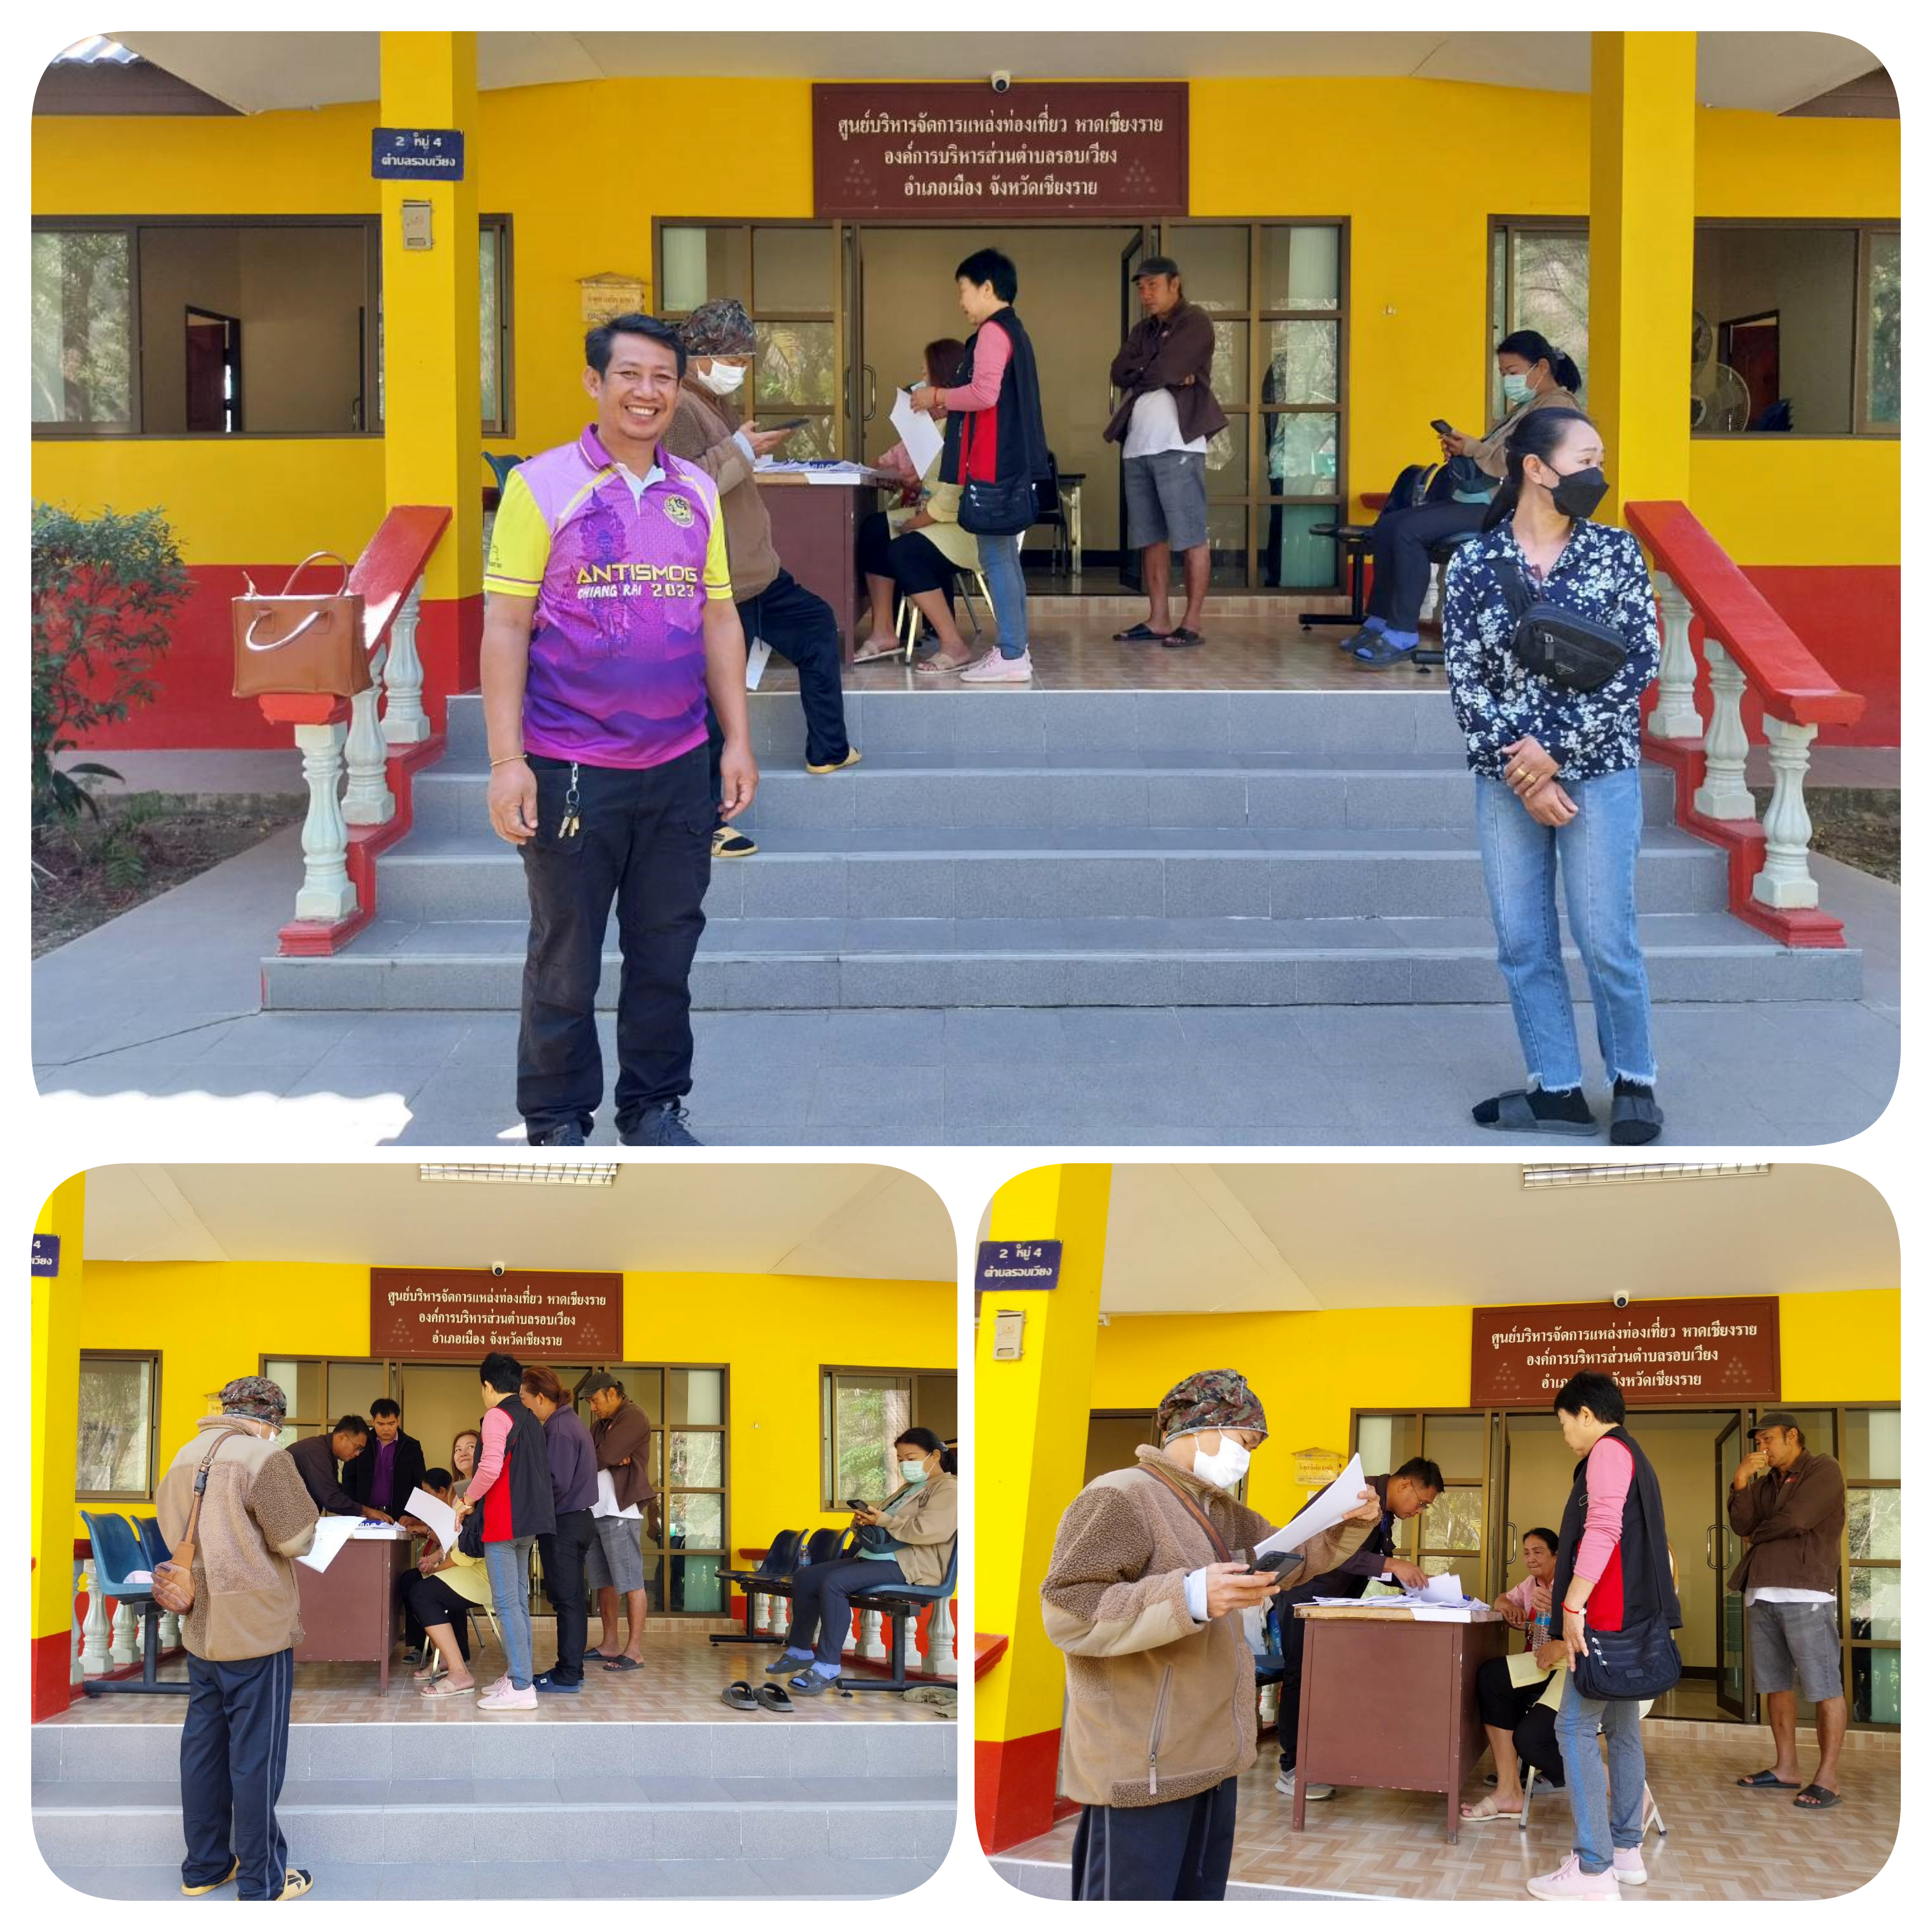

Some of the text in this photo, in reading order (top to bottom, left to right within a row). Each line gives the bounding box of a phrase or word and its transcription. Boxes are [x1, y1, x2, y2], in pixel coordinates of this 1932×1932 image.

[838, 104, 1163, 140] ศูนย์บริหารจัดการแหล่งท่องเที่ยว หาดเชียงราย
[395, 136, 405, 146] 2
[433, 137, 442, 147] 4
[381, 153, 456, 167] ตำบลรอบเวียง
[884, 141, 1117, 165] องค์การบริหารส่วนตำบลรอบเวียง
[904, 175, 1098, 196] อำเภอเมือง จังหวัดเชียงราย
[577, 564, 698, 585] ANTISMOG
[578, 583, 695, 600] CHIANG RAI 2023
[33, 1240, 41, 1249] 4
[999, 1249, 1009, 1258] 2
[1033, 1248, 1042, 1257] 4
[984, 1265, 1053, 1278] ตำบลรอบเวียง
[387, 1285, 606, 1306] ศูนย์บริหารจัดการแหล่งท่องเที่ยว หาดเชียงราย
[419, 1307, 576, 1326] องค์การบริหารส่วนตำบลรอบเวียง
[432, 1329, 563, 1346] อำเภอเมือง จังหวัดเชียงราย
[1491, 1316, 1757, 1349] ศูนย์บริหารจัดการแหล่งท่องเที่ยว หาดเชียงราย
[1526, 1345, 1719, 1367] องค์การบริหารส่วนตำบลรอบเวียง
